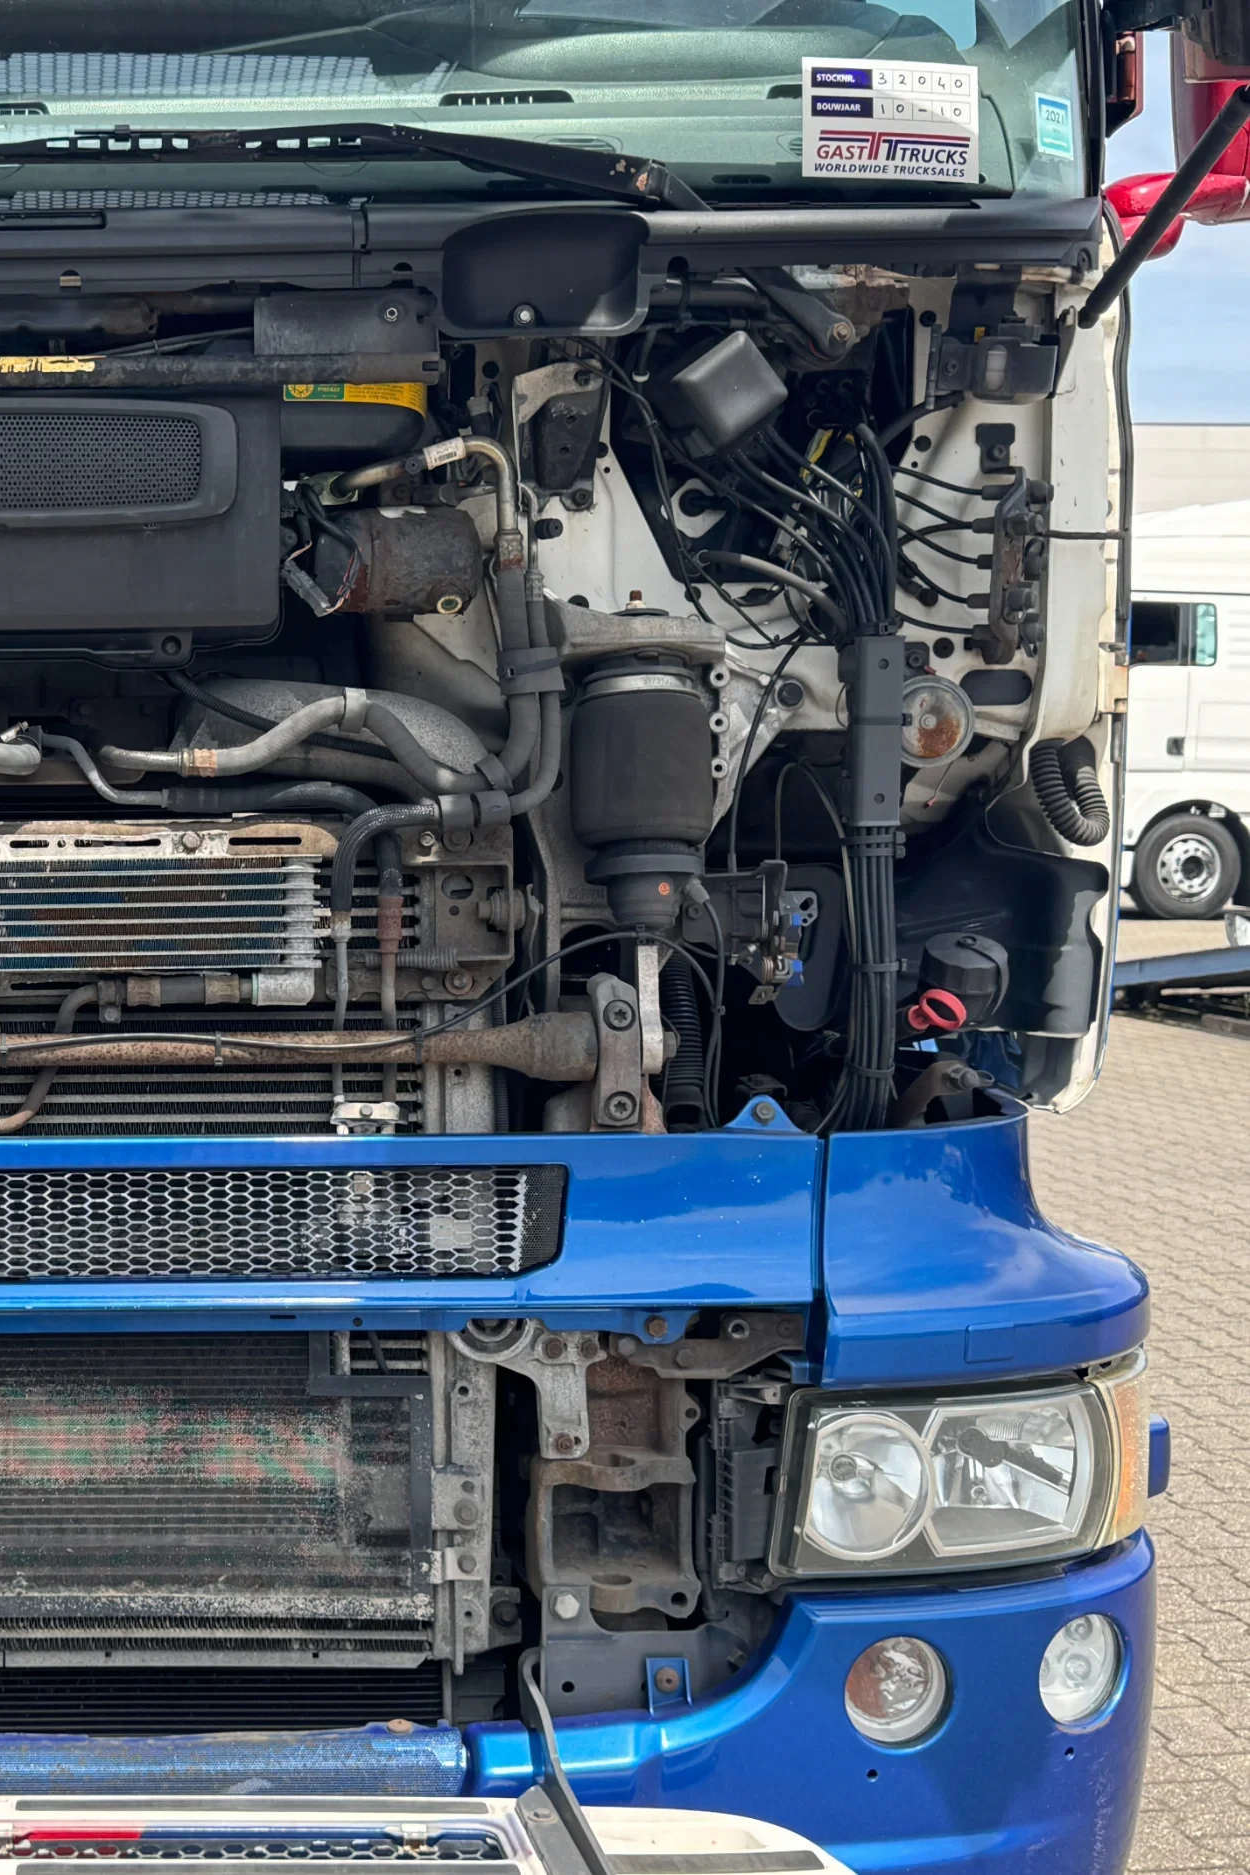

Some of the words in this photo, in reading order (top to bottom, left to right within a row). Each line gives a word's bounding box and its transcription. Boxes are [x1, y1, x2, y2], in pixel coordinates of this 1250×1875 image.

[816, 74, 855, 83] STOCKNR.
[816, 102, 861, 112] BOUWJAAR
[1045, 109, 1065, 125] 2021
[899, 147, 968, 165] TRUCKS
[814, 162, 889, 174] WORLDWIDE
[893, 164, 965, 178] TRUCKSALES
